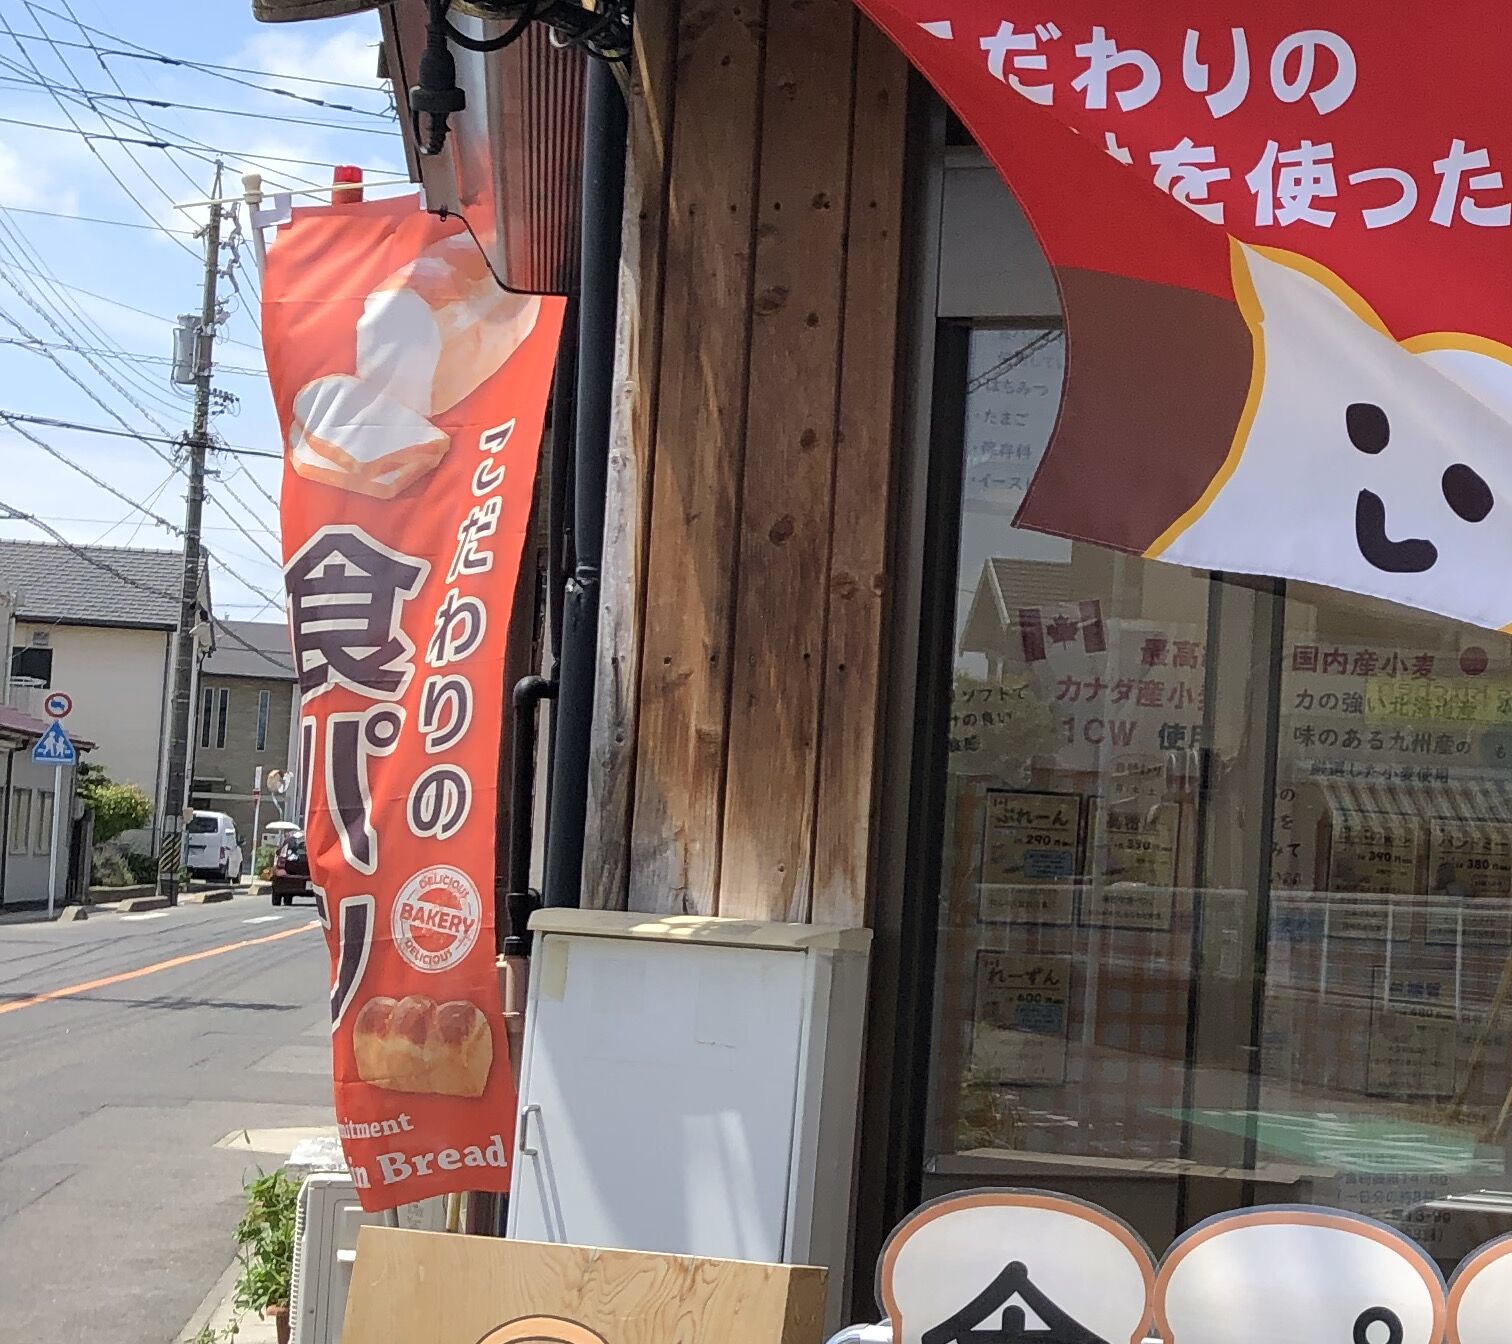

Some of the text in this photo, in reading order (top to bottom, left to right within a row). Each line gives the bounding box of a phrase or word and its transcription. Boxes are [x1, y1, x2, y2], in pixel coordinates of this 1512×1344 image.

[917, 19, 1358, 119] だわりの
[407, 417, 516, 840] こだわりの
[1141, 638, 1206, 669] 最高
[1292, 644, 1436, 681] 国内産小麦
[1056, 674, 1206, 711] カナダ産小
[1062, 716, 1136, 747] 1CW
[400, 902, 476, 935] BAKERY
[376, 1134, 508, 1185] Bread
